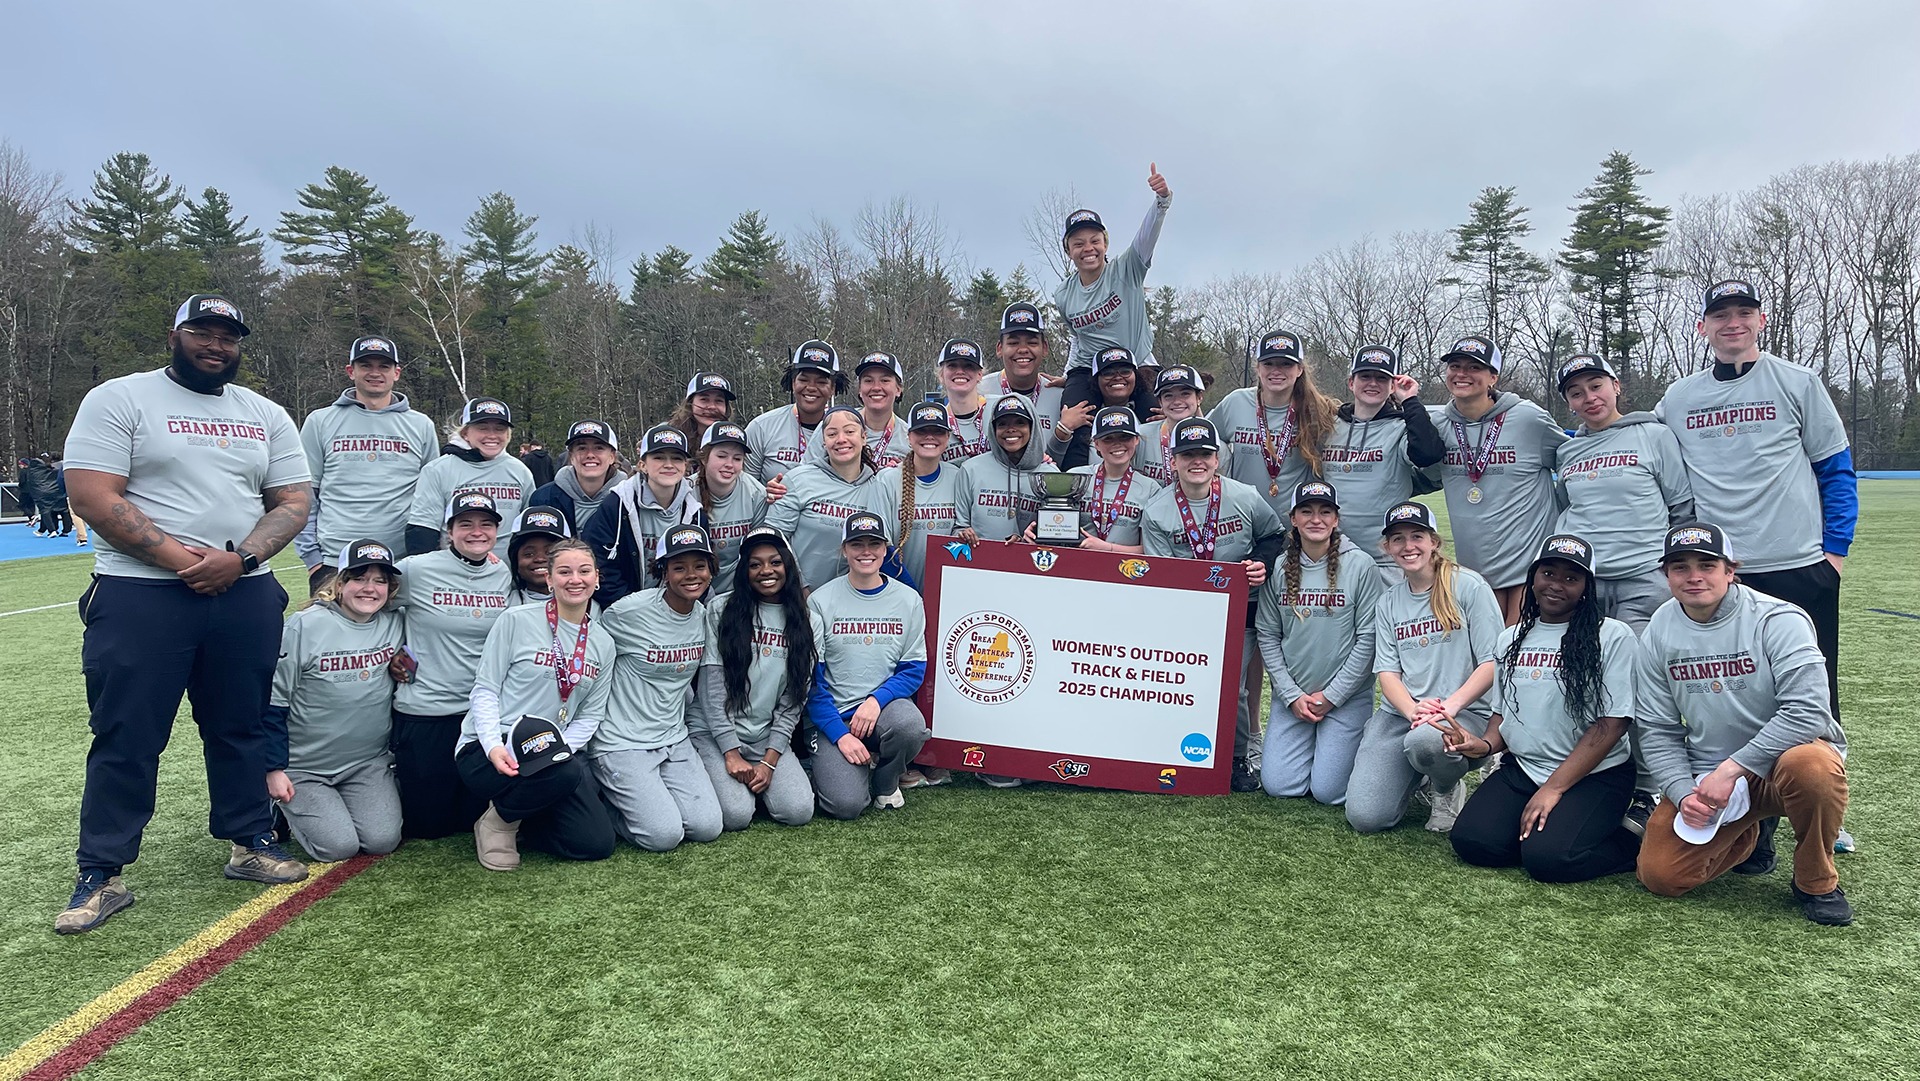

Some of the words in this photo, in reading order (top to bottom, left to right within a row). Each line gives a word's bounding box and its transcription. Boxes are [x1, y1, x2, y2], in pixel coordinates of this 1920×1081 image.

[1687, 406, 1776, 430] CHAMPIONS
[167, 420, 266, 442] CHAMPIONS
[333, 439, 409, 453] CHAMPIONS
[1279, 421, 1292, 460] COMMUNITY
[1480, 421, 1500, 464] COMMUNITY
[1562, 454, 1638, 477] CHAMPIONS
[898, 508, 956, 521] CAMPION
[1670, 529, 1712, 547] CHAMPIONS
[1548, 540, 1586, 558] CHAMPIONS
[1277, 593, 1345, 607] CHMPIONS
[832, 622, 903, 635] CHAMPIONS
[971, 631, 997, 644] GREAT
[647, 646, 705, 663] CHAMPION
[946, 617, 973, 675] COMMUNITY
[969, 643, 1015, 658] NORTHEAST
[984, 614, 1033, 684] SPORTSMANSHIP
[1051, 639, 1126, 658] WOMEN'S
[1130, 647, 1209, 666] OUTDOOR
[320, 647, 394, 672] CHAMPIONS
[966, 655, 1005, 669] ATHLETIC
[964, 667, 1013, 682] CONFERENCE
[1071, 662, 1122, 679] TRACK
[1125, 667, 1137, 680] &
[1141, 669, 1186, 685] FIELD
[1669, 658, 1756, 681] CHAMPIONS
[958, 683, 1015, 702] INTEGRITY
[1058, 681, 1096, 696] 2025
[1100, 685, 1195, 706] CHAMPIONS
[1183, 746, 1211, 756] NCAA
[1071, 763, 1088, 776] SJC
